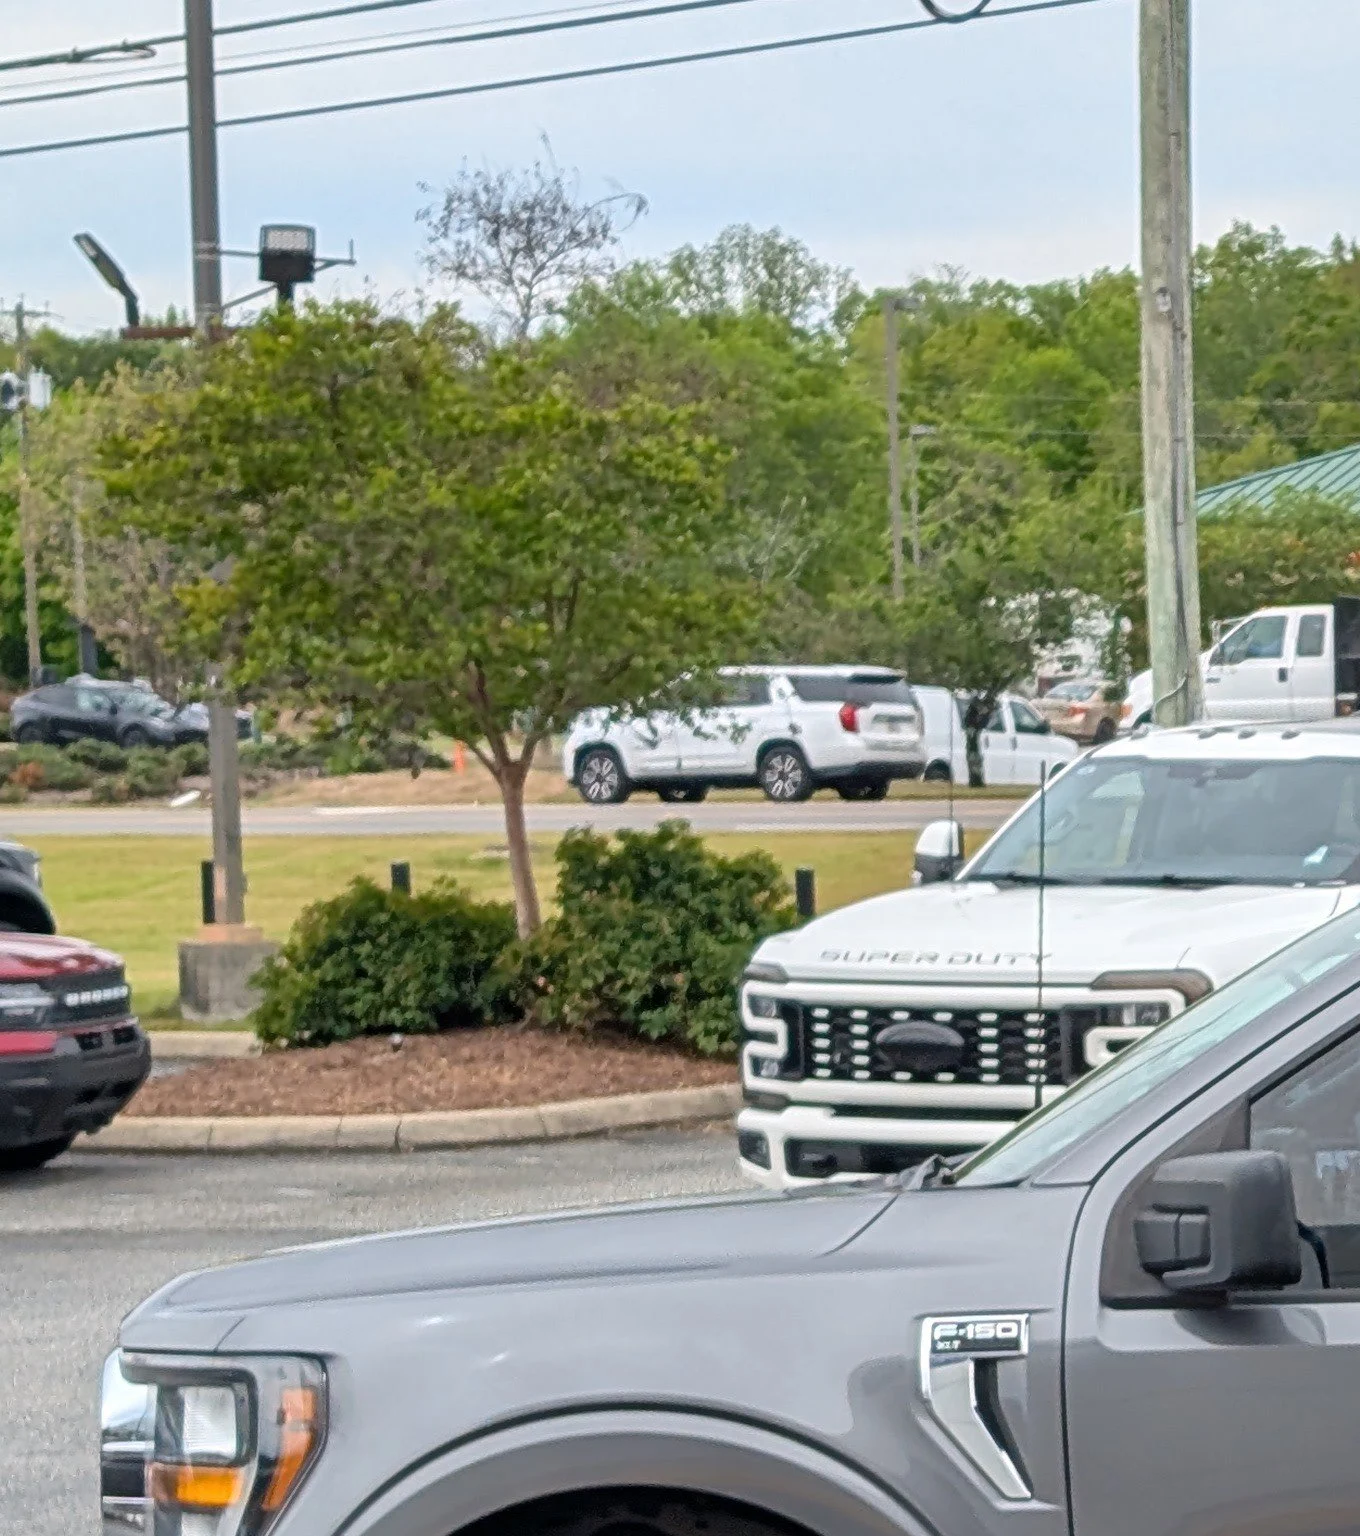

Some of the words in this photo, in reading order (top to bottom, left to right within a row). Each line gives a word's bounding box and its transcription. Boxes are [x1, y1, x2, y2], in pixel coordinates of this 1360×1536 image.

[820, 950, 940, 963] SUPER
[948, 952, 1052, 965] DUTY
[934, 1322, 1018, 1340] F-150
